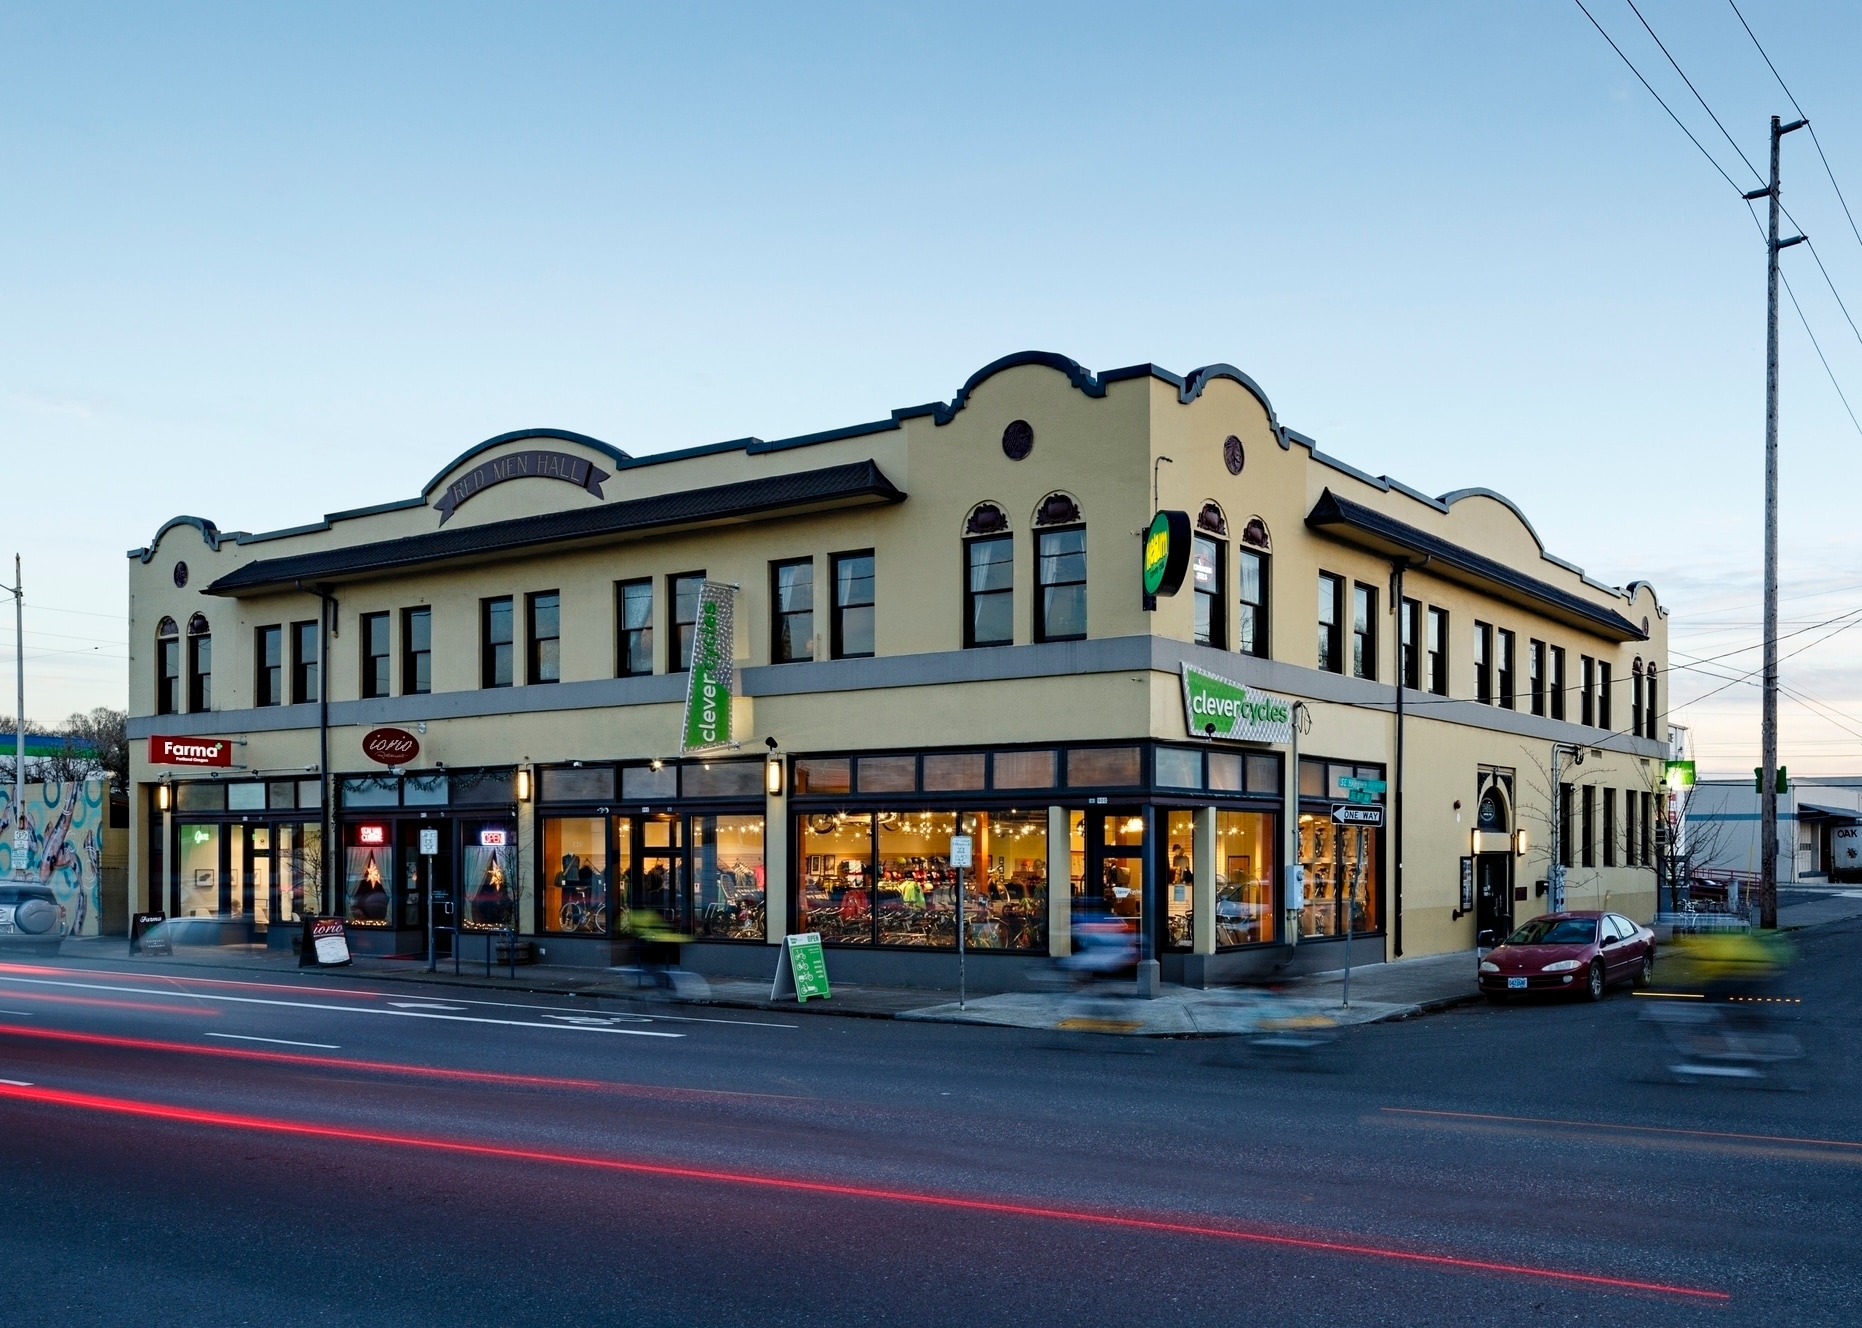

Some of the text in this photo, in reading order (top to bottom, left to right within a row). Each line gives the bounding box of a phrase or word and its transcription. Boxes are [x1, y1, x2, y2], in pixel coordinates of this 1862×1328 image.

[453, 454, 580, 501] RED MEN HALL
[699, 600, 719, 742] cycles clever
[1193, 690, 1288, 725] clever cycles
[164, 742, 217, 757] Farma
[370, 734, 413, 752] iorio
[1344, 810, 1379, 820] ONE WAY
[484, 833, 503, 843] OPEN
[1837, 829, 1858, 838] OAK
[313, 922, 343, 934] iorio
